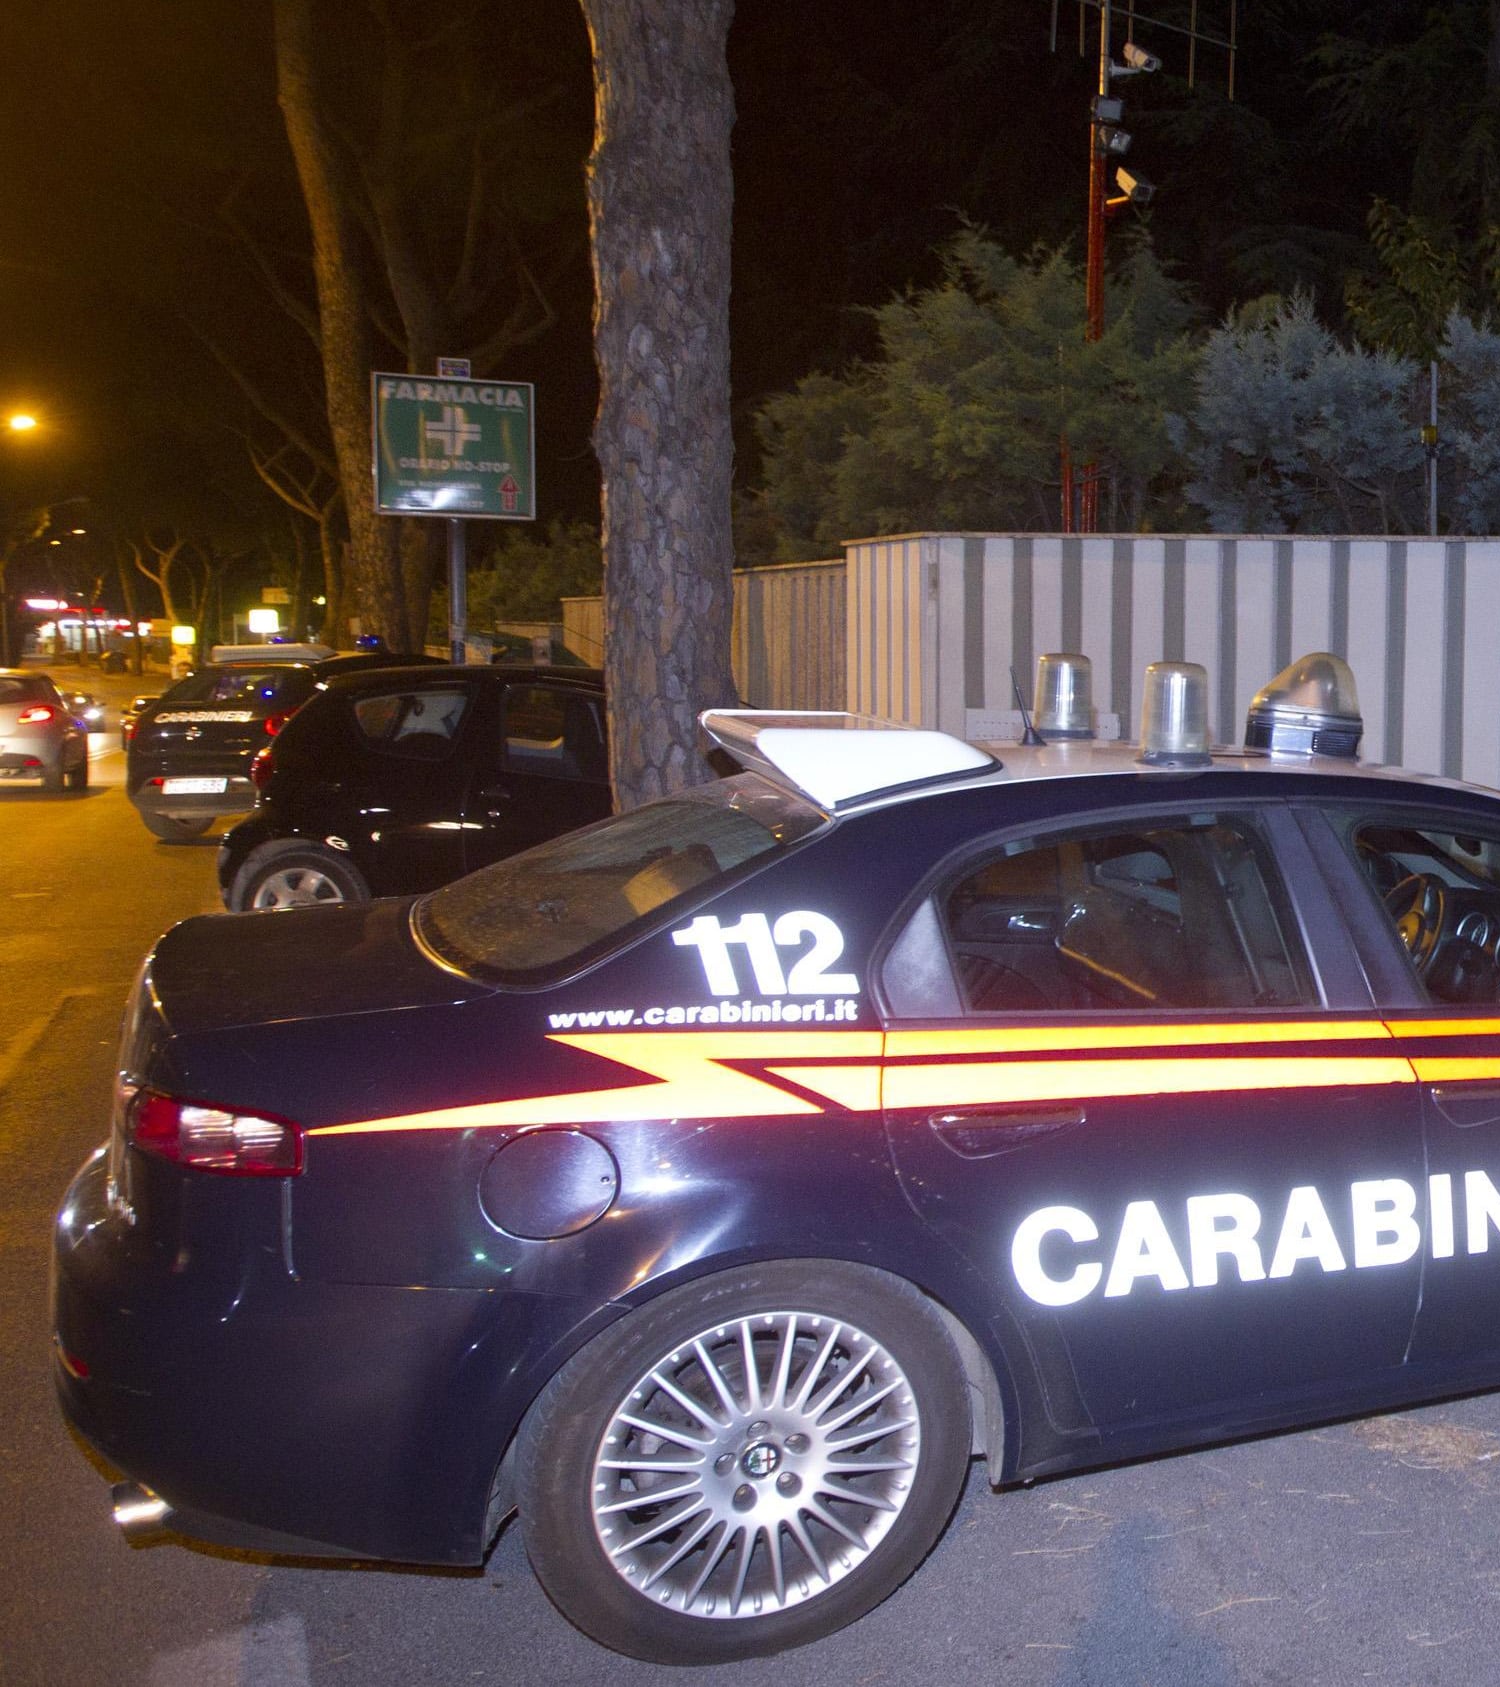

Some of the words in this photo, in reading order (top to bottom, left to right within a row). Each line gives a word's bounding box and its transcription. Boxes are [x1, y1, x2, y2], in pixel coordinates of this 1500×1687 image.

[380, 380, 524, 407] FARMACIA
[154, 711, 253, 723] CARABINIERI
[672, 910, 861, 996] 112
[548, 999, 859, 1029] www.carabinieri.it
